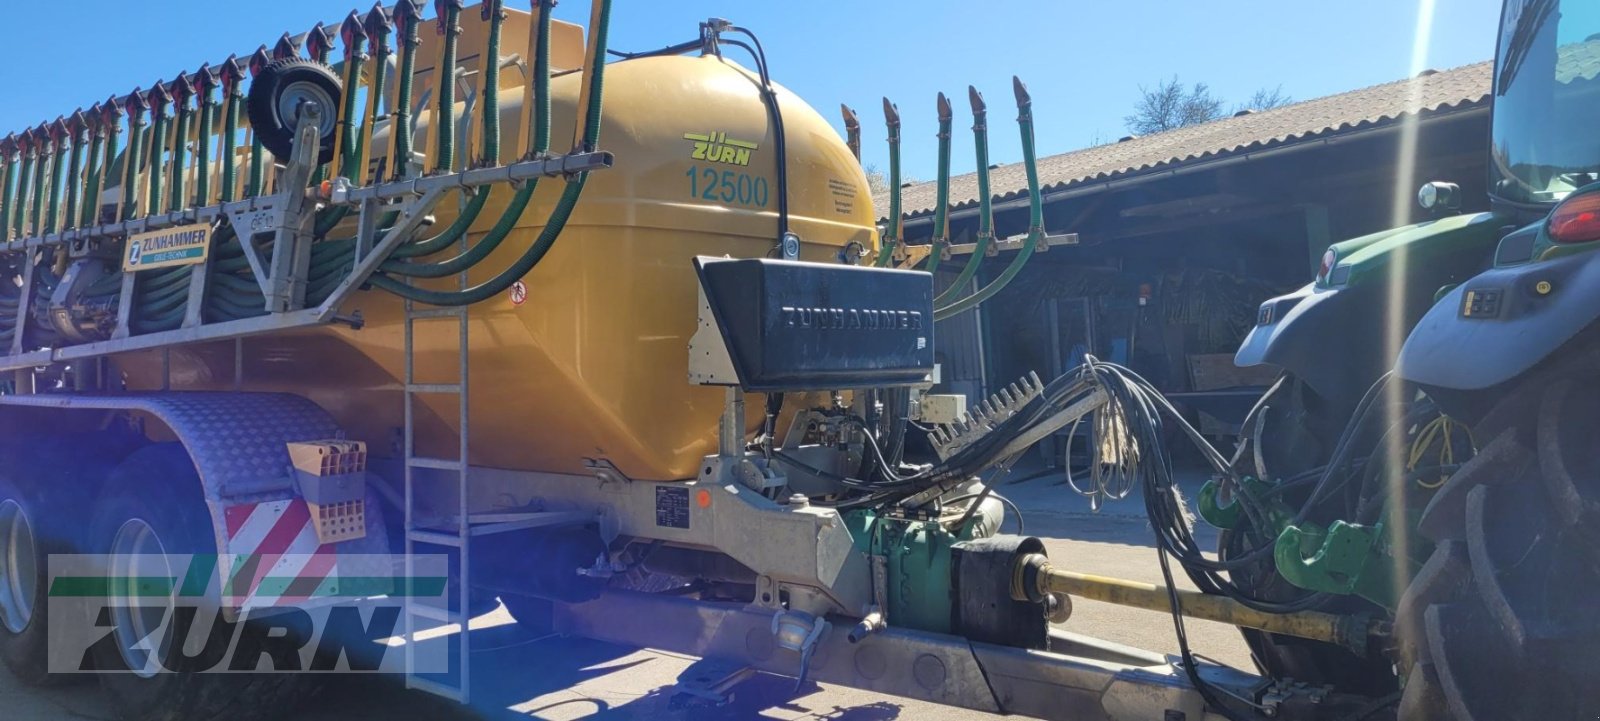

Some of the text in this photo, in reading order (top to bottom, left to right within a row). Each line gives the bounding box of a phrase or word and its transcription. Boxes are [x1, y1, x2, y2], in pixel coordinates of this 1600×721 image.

[688, 131, 752, 167] ZÜRN
[686, 164, 769, 208] 12500
[142, 229, 206, 252] ZUNHAMMER
[782, 306, 923, 330] ZUNHAMMER
